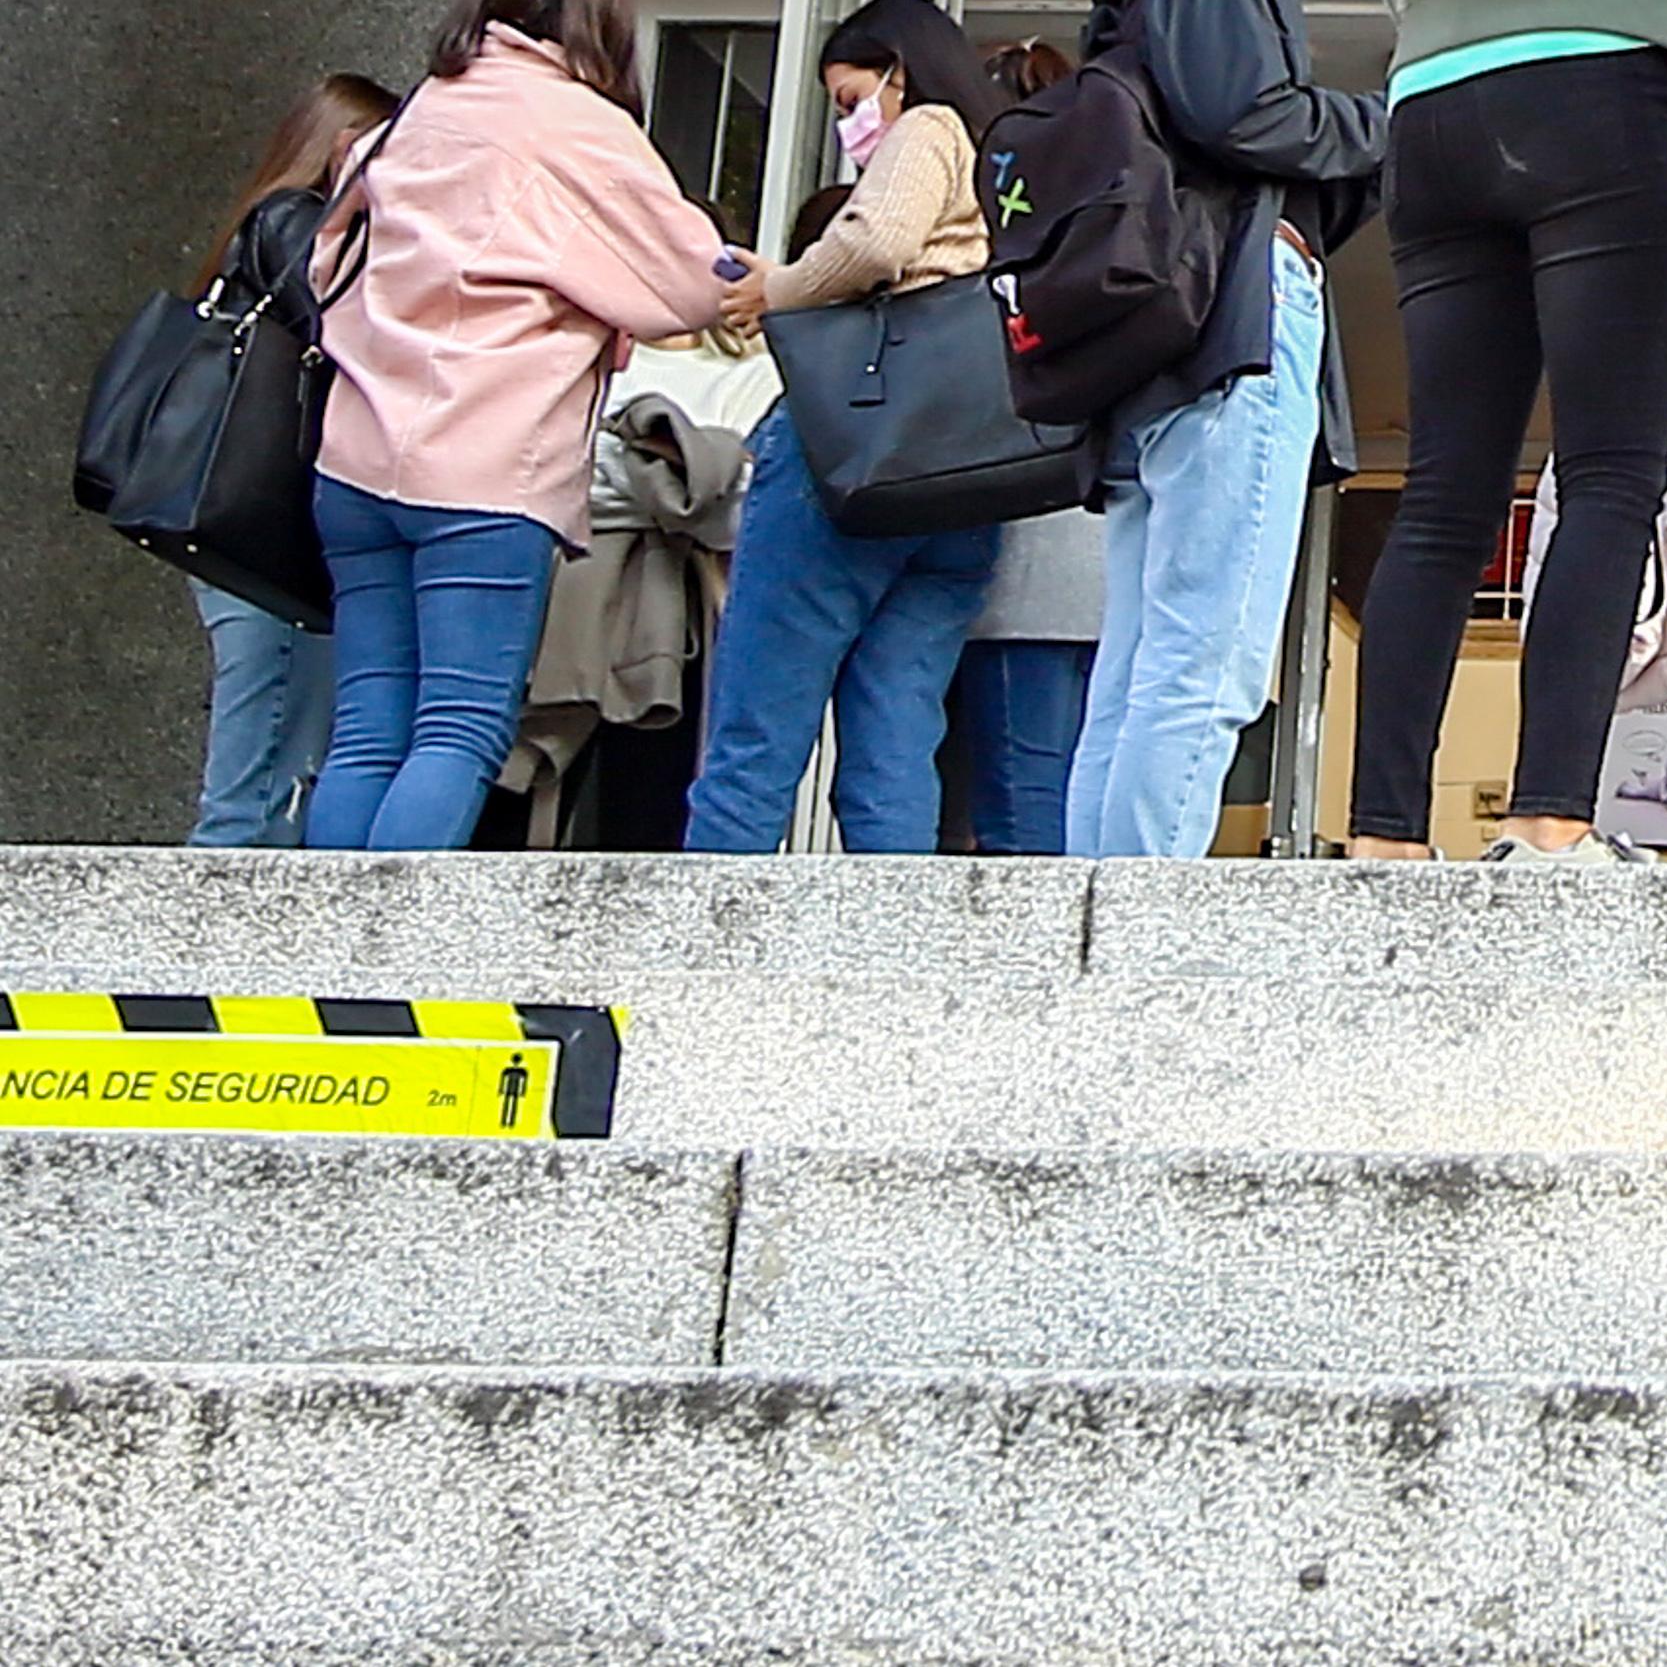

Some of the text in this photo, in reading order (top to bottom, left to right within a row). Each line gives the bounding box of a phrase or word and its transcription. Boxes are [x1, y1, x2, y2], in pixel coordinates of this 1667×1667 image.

[100, 1070, 158, 1101] DE
[164, 1070, 391, 1106] SEGURIDAD
[427, 1089, 458, 1107] 2m
